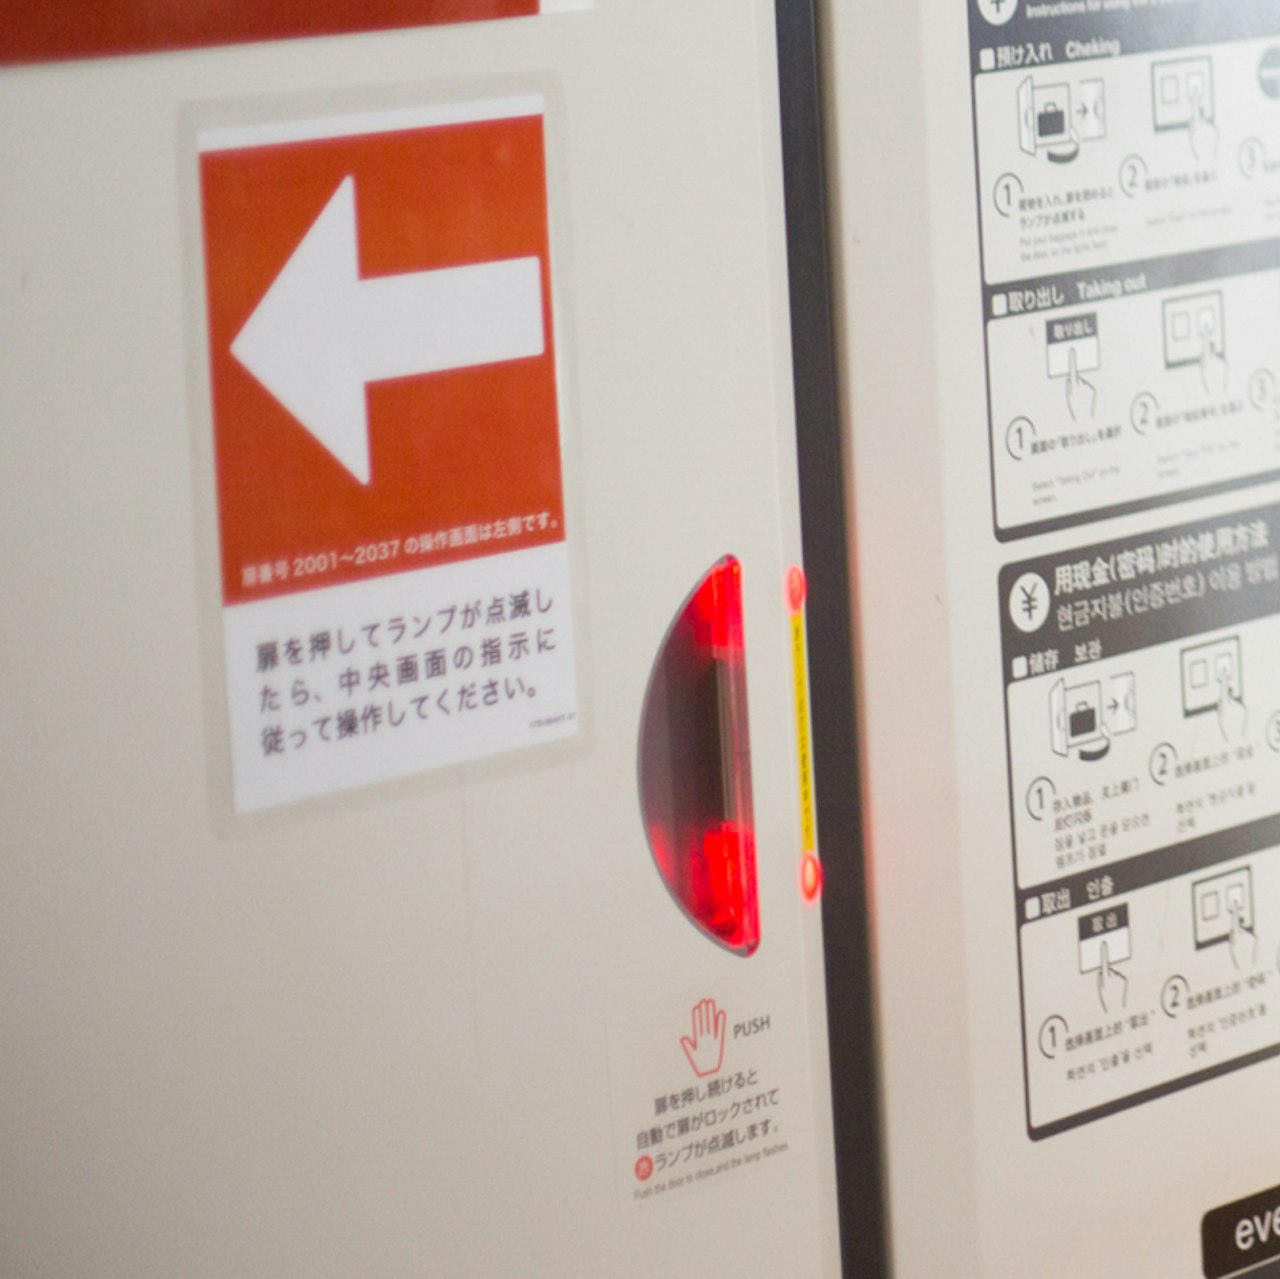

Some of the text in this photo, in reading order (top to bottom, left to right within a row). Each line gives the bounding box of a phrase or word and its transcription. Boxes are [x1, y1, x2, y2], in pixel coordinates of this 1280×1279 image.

[997, 42, 1053, 68] 預け入れ
[1128, 164, 1138, 188] 2
[1003, 184, 1011, 206] 1
[1009, 286, 1065, 313] 取り出し
[1077, 273, 1147, 301] Taking out
[1139, 401, 1149, 426] 2
[1015, 426, 1023, 450] 1
[242, 558, 288, 586] 扉番号
[1057, 571, 1207, 632] 현금지불(인증번호)
[1208, 562, 1244, 592] 이용
[256, 587, 554, 673] 扉を押してランプが点滅し
[259, 628, 556, 714] たら、中央画面の指示に
[261, 676, 538, 757] 従って操作してください。
[1158, 752, 1168, 776] 2
[1036, 786, 1045, 810] 1
[1086, 874, 1114, 900] 인출
[1041, 887, 1072, 915] 取出
[1169, 984, 1180, 1009] 2
[733, 1014, 771, 1039] PUSH
[1048, 1025, 1057, 1049] 1
[654, 1069, 759, 1116] 扉を押し続けると
[636, 1088, 780, 1150] 自動で扉がロックされて
